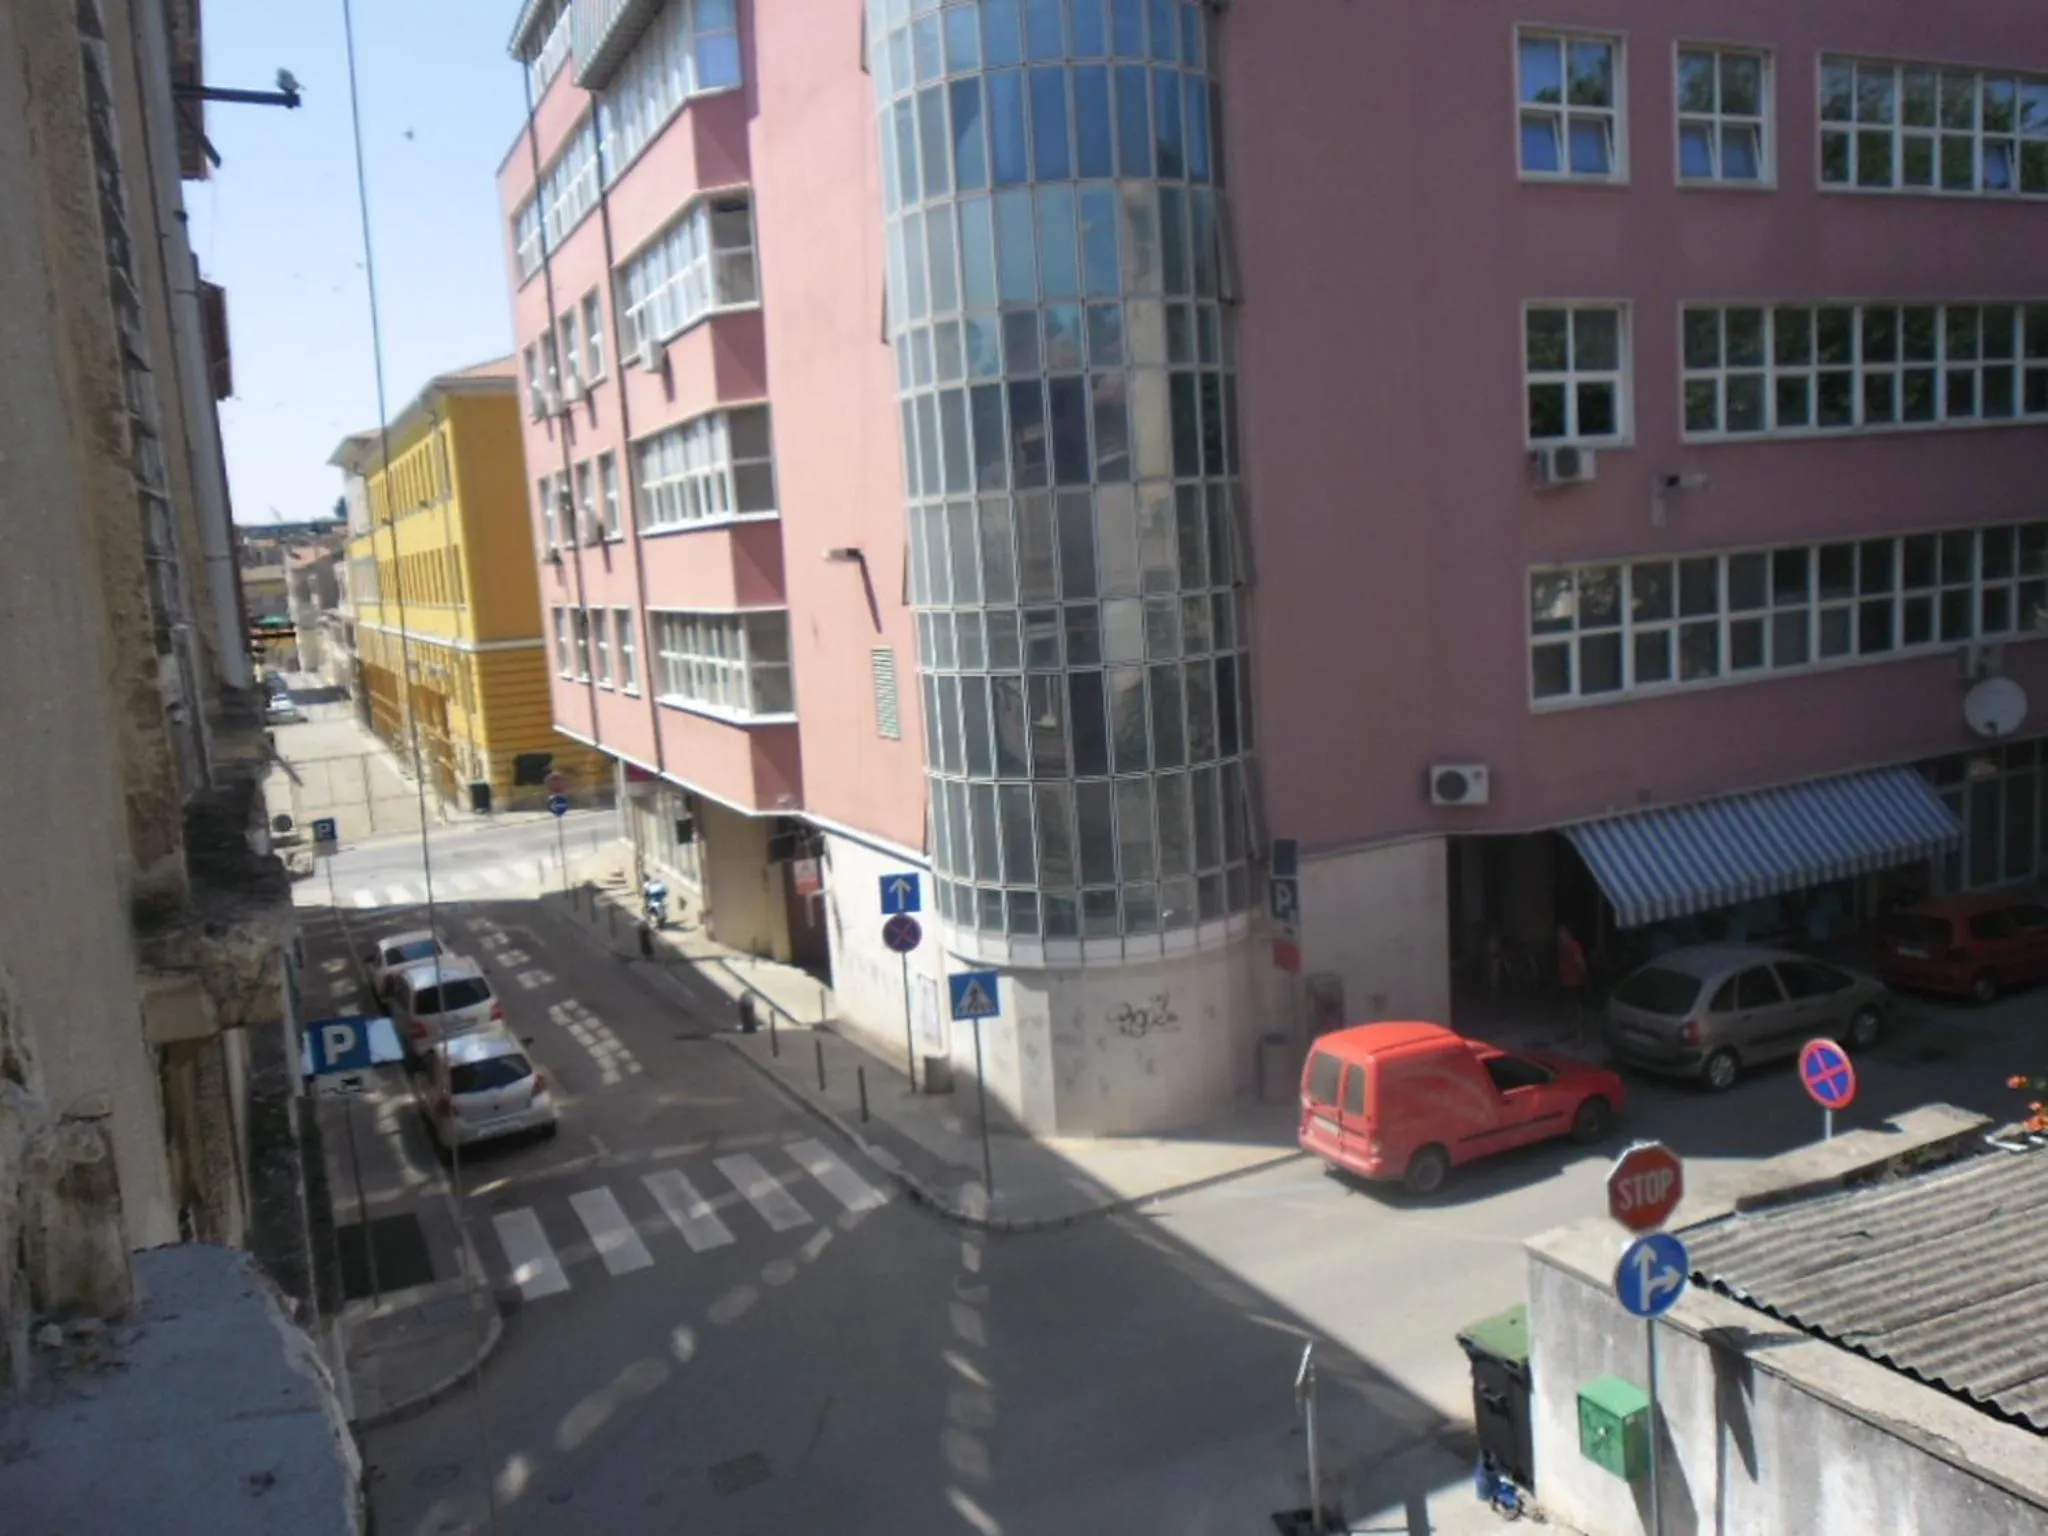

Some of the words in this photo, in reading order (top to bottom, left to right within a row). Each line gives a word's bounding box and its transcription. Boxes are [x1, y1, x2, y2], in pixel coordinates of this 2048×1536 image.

[315, 822, 331, 839] P
[1276, 884, 1292, 912] P
[321, 1025, 355, 1065] P
[1617, 1168, 1674, 1210] STOP
